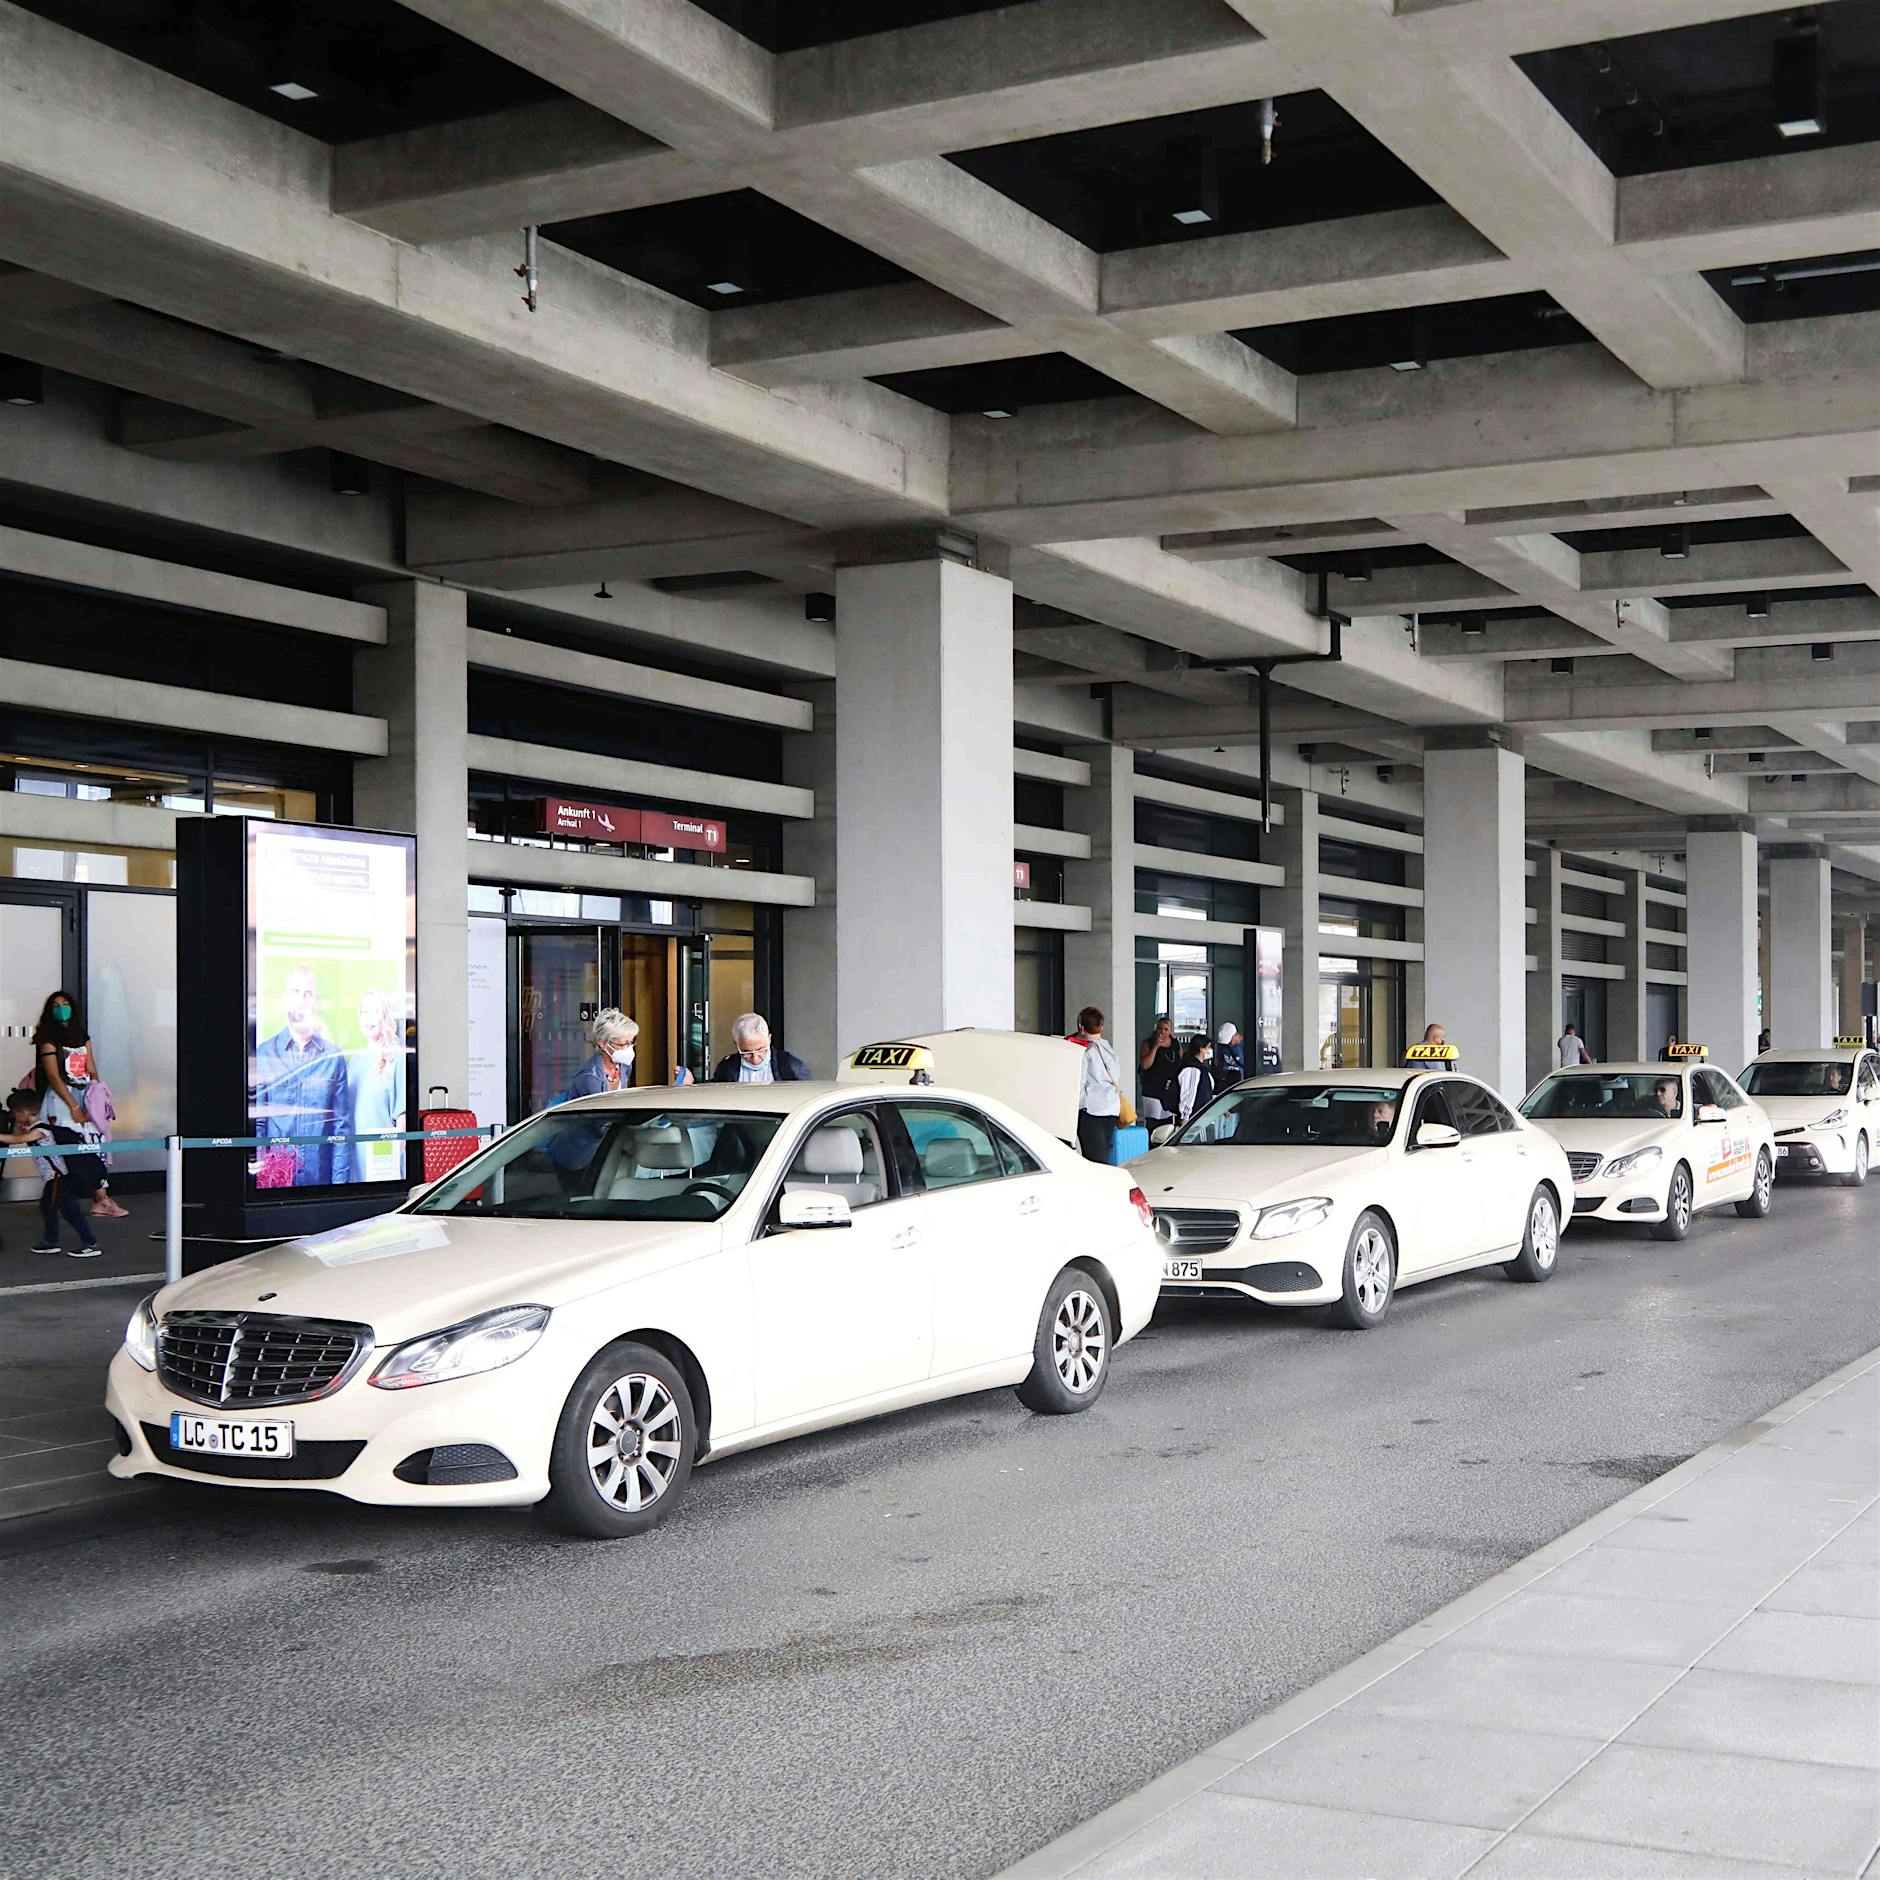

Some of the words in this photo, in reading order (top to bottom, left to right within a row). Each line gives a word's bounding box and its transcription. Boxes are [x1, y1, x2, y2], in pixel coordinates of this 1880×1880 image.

[558, 805, 590, 819] Ankunft
[592, 810, 596, 820] 1
[557, 818, 577, 828] Arrival
[578, 820, 582, 828] 1
[672, 820, 703, 833] Terminal
[706, 829, 717, 842] T1
[1015, 869, 1024, 880] T1
[861, 1048, 909, 1064] TAXI
[1415, 1047, 1449, 1057] TAXI
[1675, 1046, 1699, 1054] TAXI
[1777, 1148, 1788, 1156] 86
[1172, 1262, 1198, 1277] 875
[184, 1420, 205, 1447] LC
[218, 1424, 245, 1450] TC
[250, 1426, 278, 1452] 15
